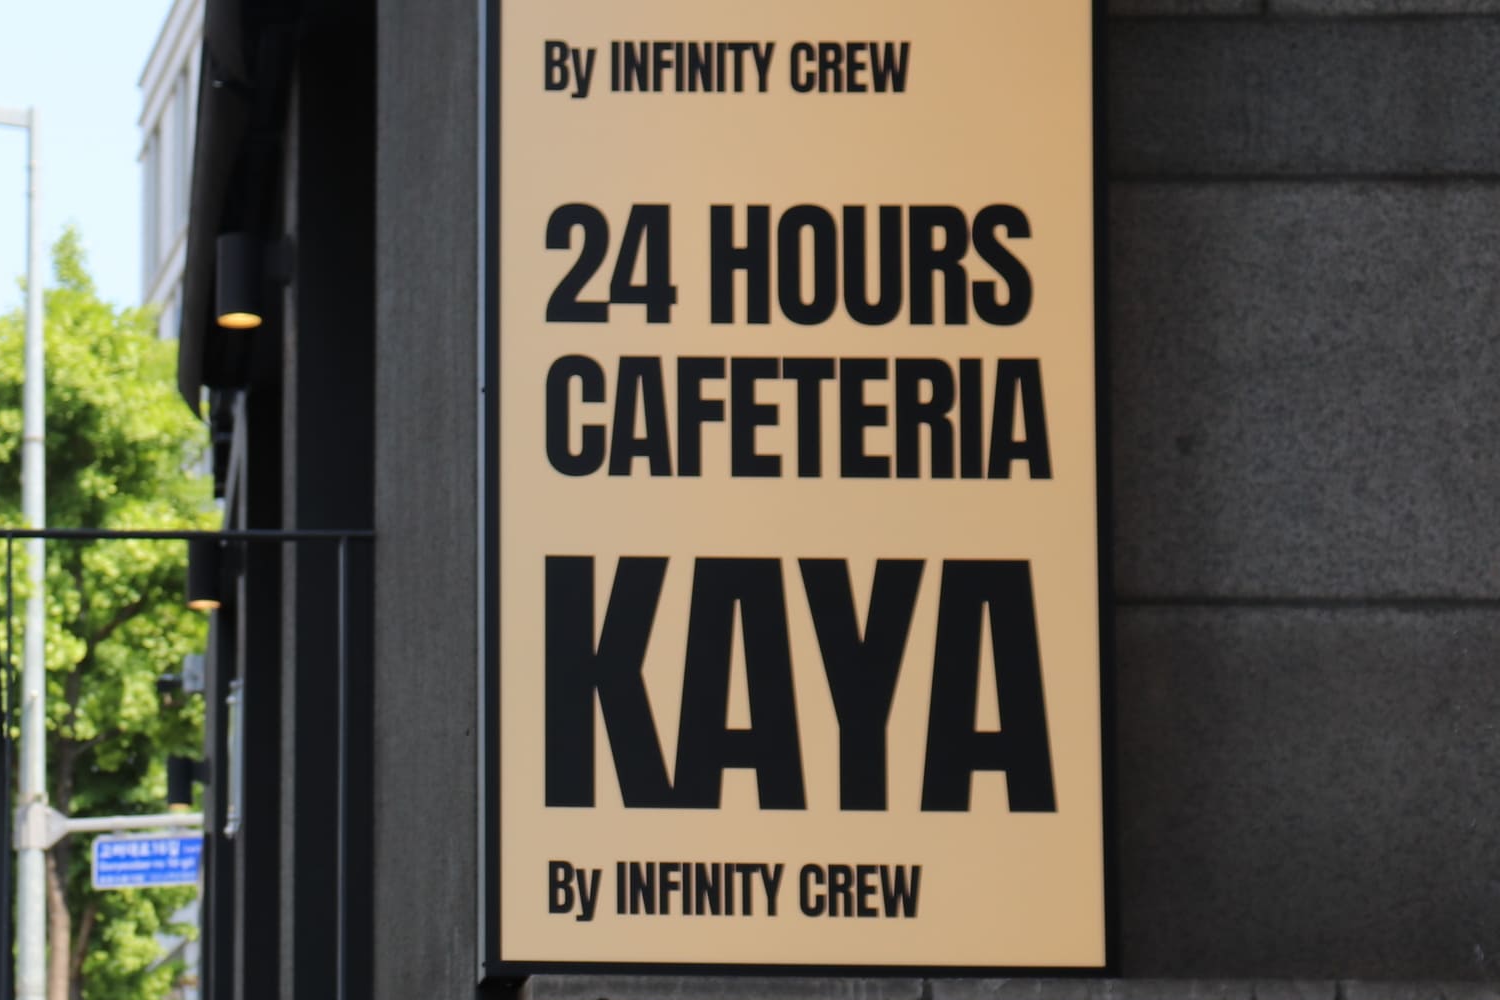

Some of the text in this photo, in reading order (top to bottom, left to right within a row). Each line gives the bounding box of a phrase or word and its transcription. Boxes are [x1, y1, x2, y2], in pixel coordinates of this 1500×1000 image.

[543, 40, 911, 98] By INFINITY CREW
[544, 203, 1034, 326] 24 HOURS
[544, 353, 1054, 480] CAFETERIA
[544, 554, 1059, 813] KAYA
[547, 860, 923, 922] By INFINITY CREW
